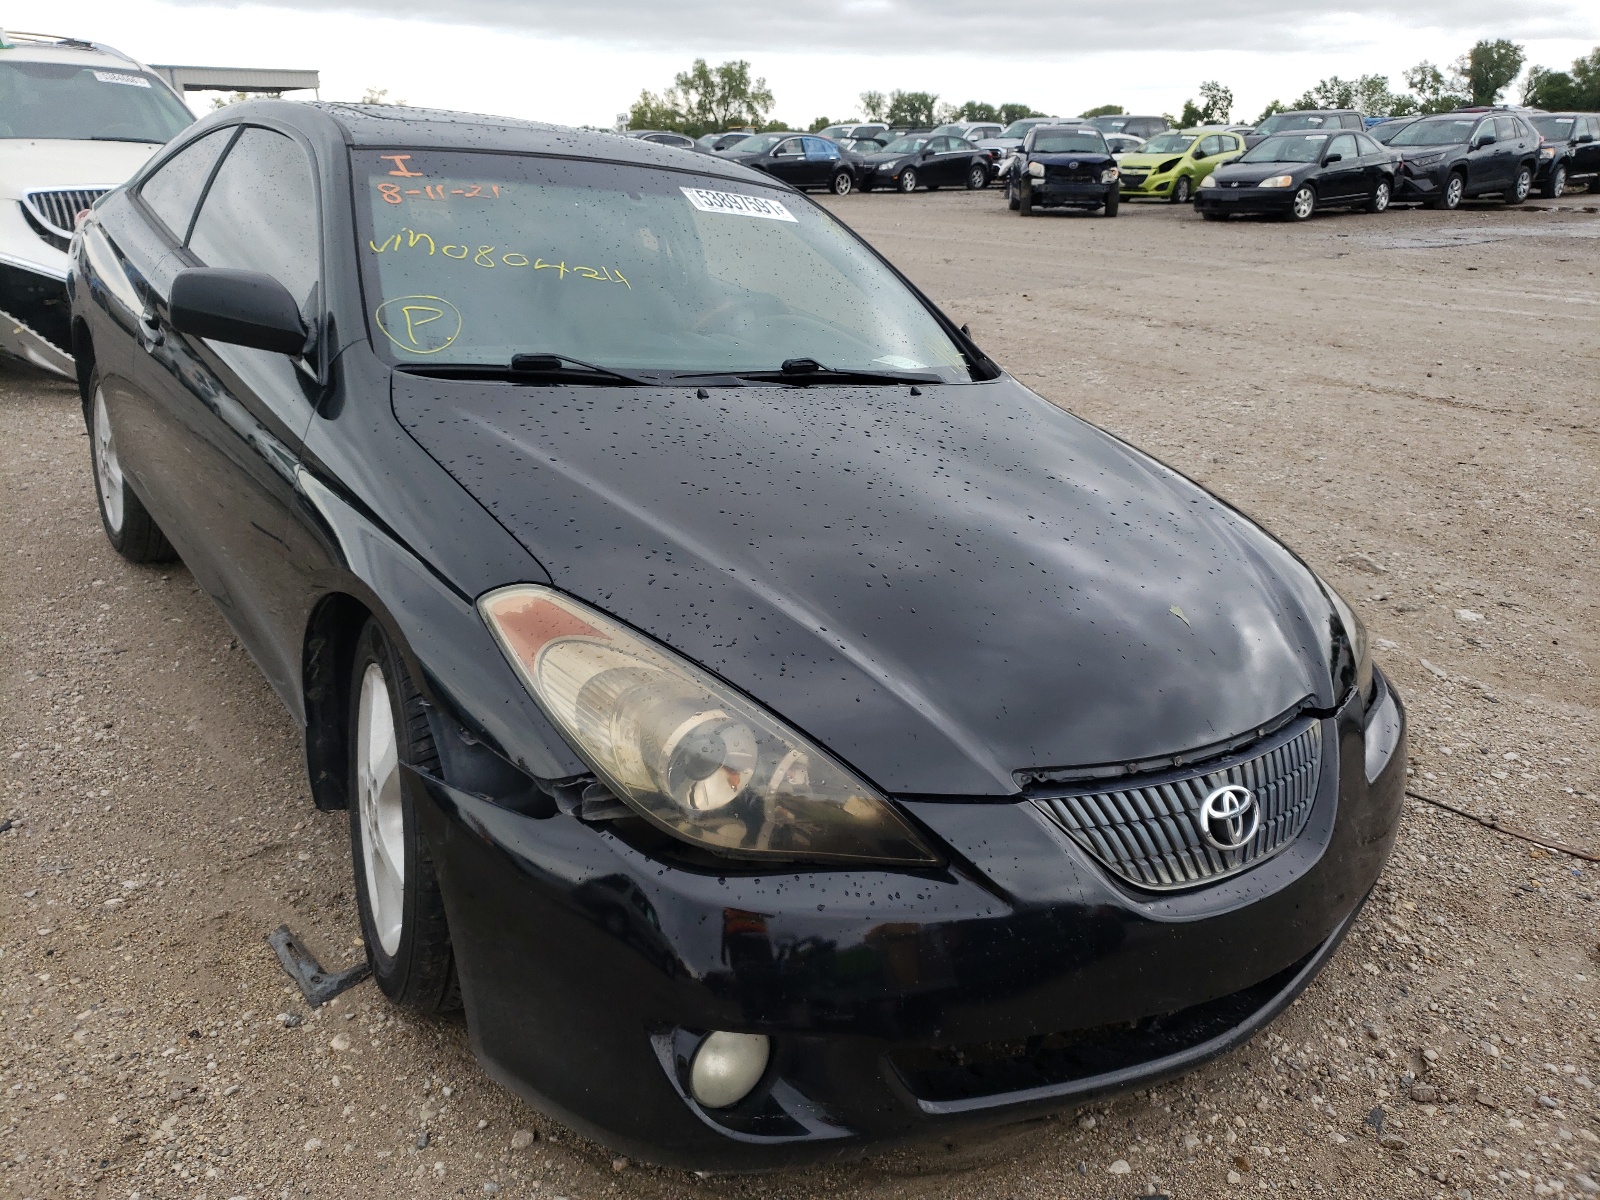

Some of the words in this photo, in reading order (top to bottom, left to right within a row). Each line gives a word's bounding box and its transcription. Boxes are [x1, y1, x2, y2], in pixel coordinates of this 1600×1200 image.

[377, 183, 499, 204] 8-11-21
[695, 189, 780, 216] 53897591
[402, 306, 443, 344] P
